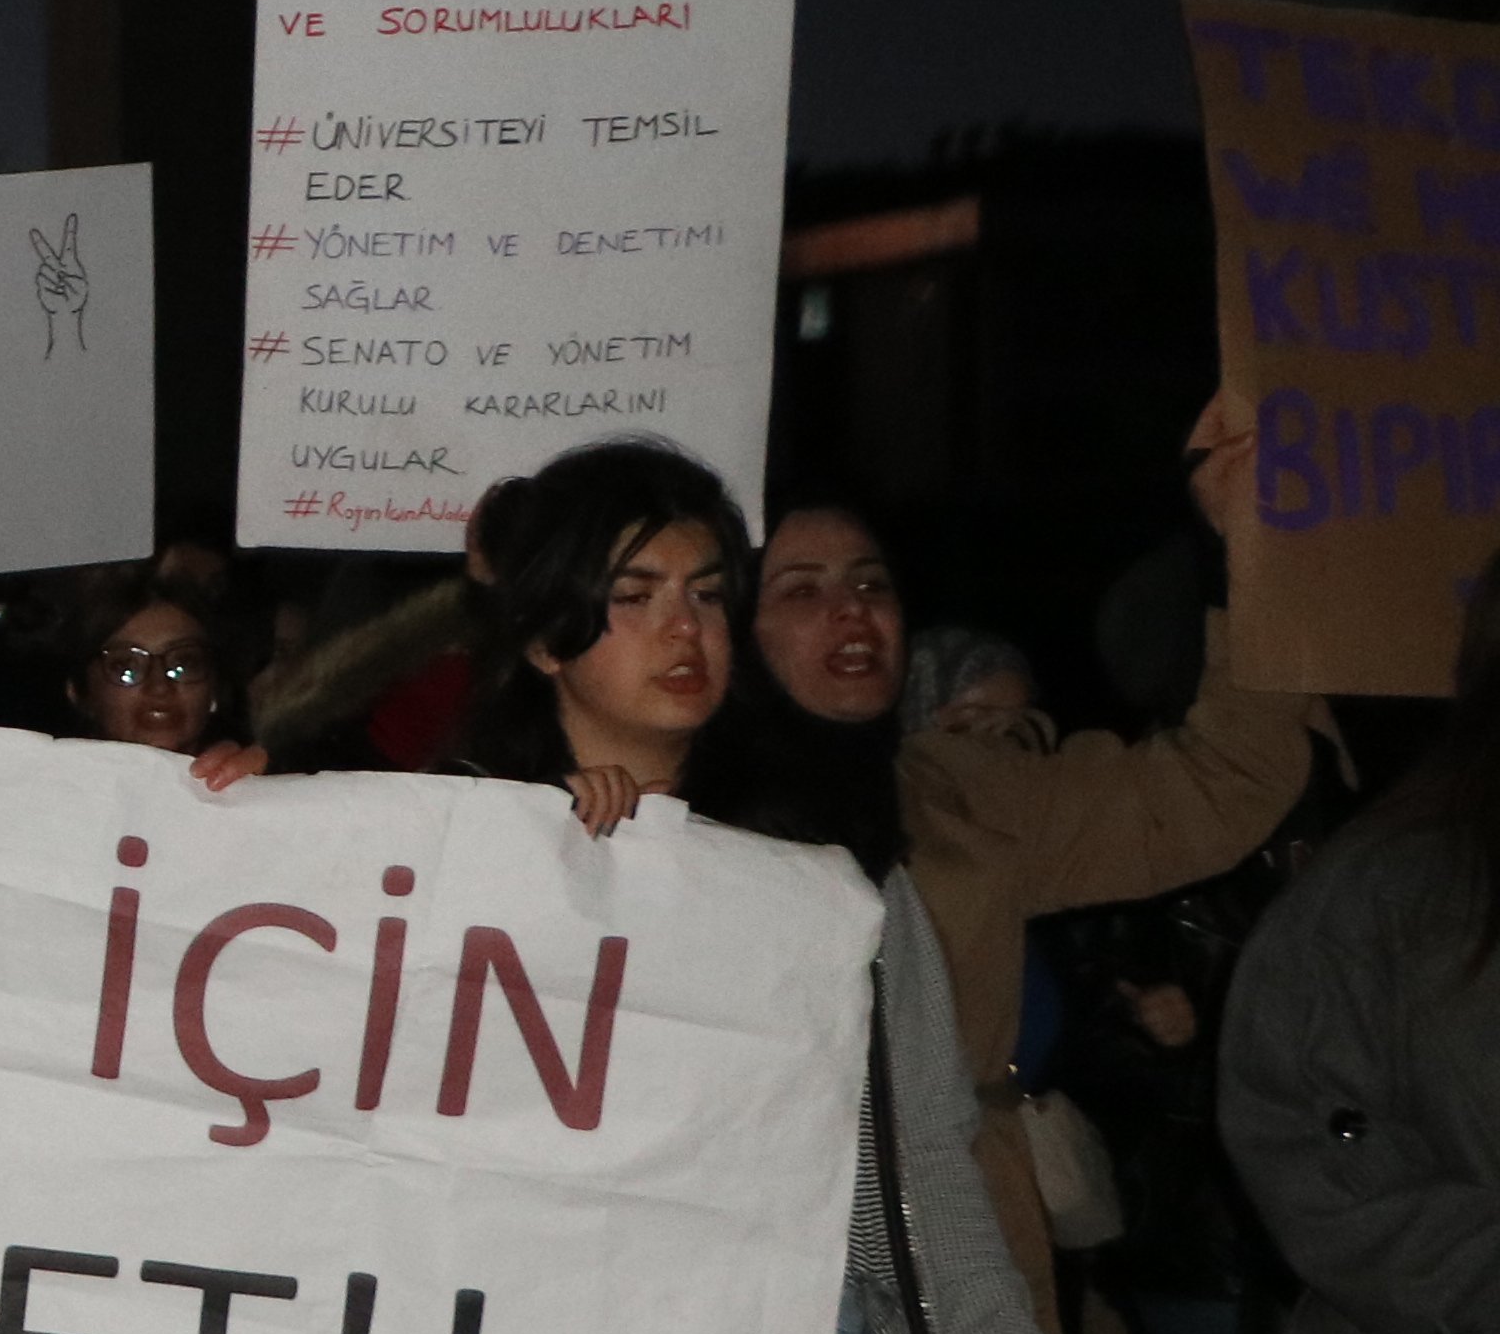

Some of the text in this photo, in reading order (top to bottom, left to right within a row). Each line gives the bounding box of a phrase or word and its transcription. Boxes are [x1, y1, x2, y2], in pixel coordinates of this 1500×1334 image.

[278, 2, 693, 37] VE SORUMLULUKLARI
[581, 108, 720, 148] TEMSİL
[486, 233, 520, 258] VE
[475, 342, 512, 366] VE
[300, 385, 669, 419] KURULU KARARLARINI
[90, 834, 629, 1147] İÇİN
